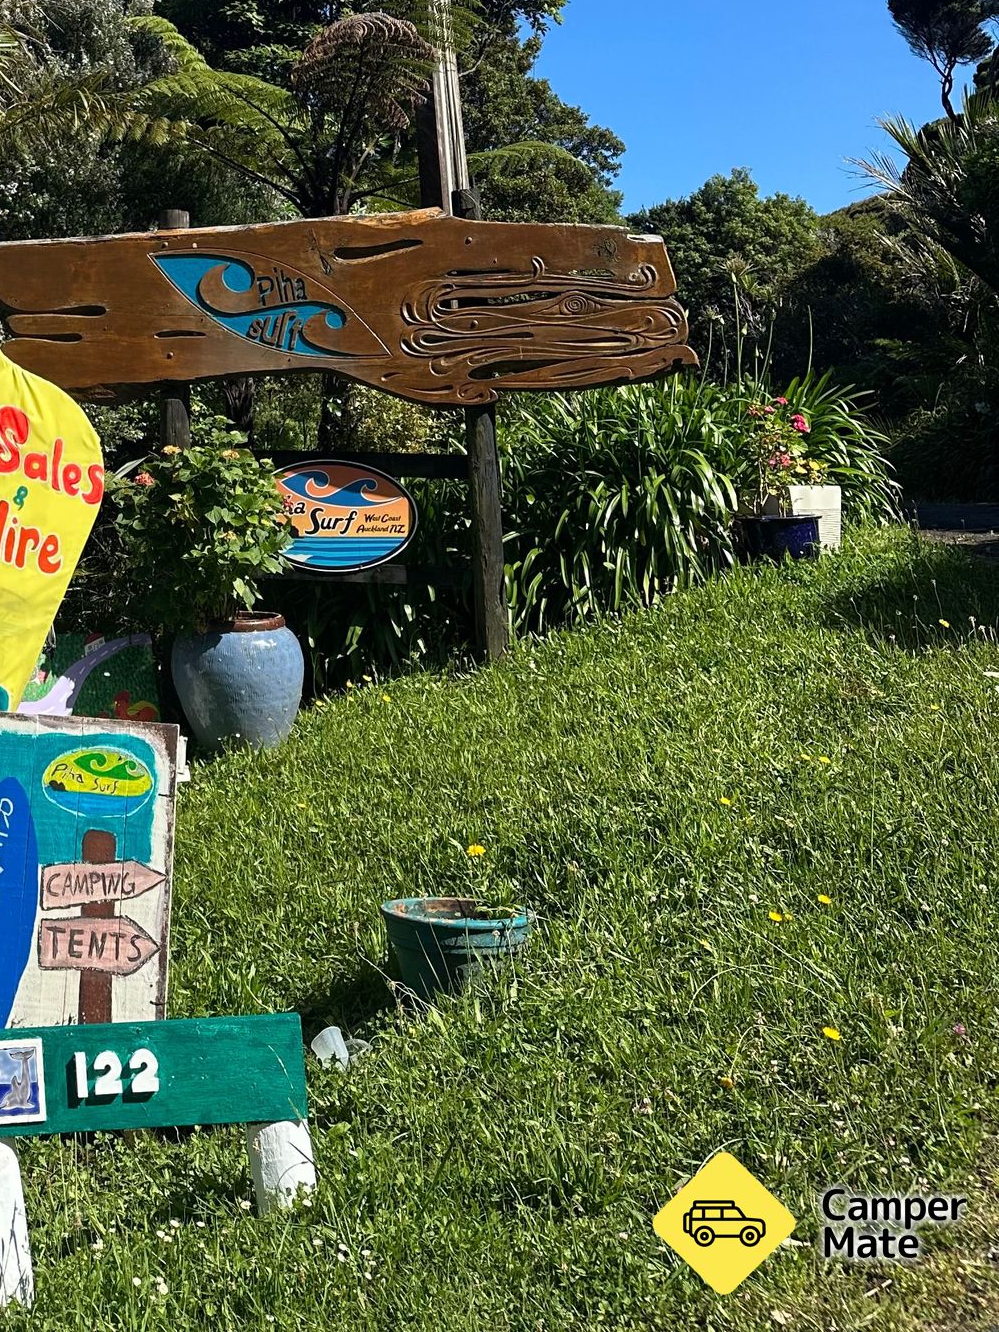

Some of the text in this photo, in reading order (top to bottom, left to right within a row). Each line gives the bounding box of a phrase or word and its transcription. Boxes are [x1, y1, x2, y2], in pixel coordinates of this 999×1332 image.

[13, 486, 28, 510] &
[304, 507, 358, 536] Surf
[356, 524, 406, 534] Auckland NZ
[51, 763, 119, 795] Piha Surf
[46, 868, 137, 899] CAMPING
[47, 927, 144, 962] TENTS
[74, 1048, 159, 1098] 122
